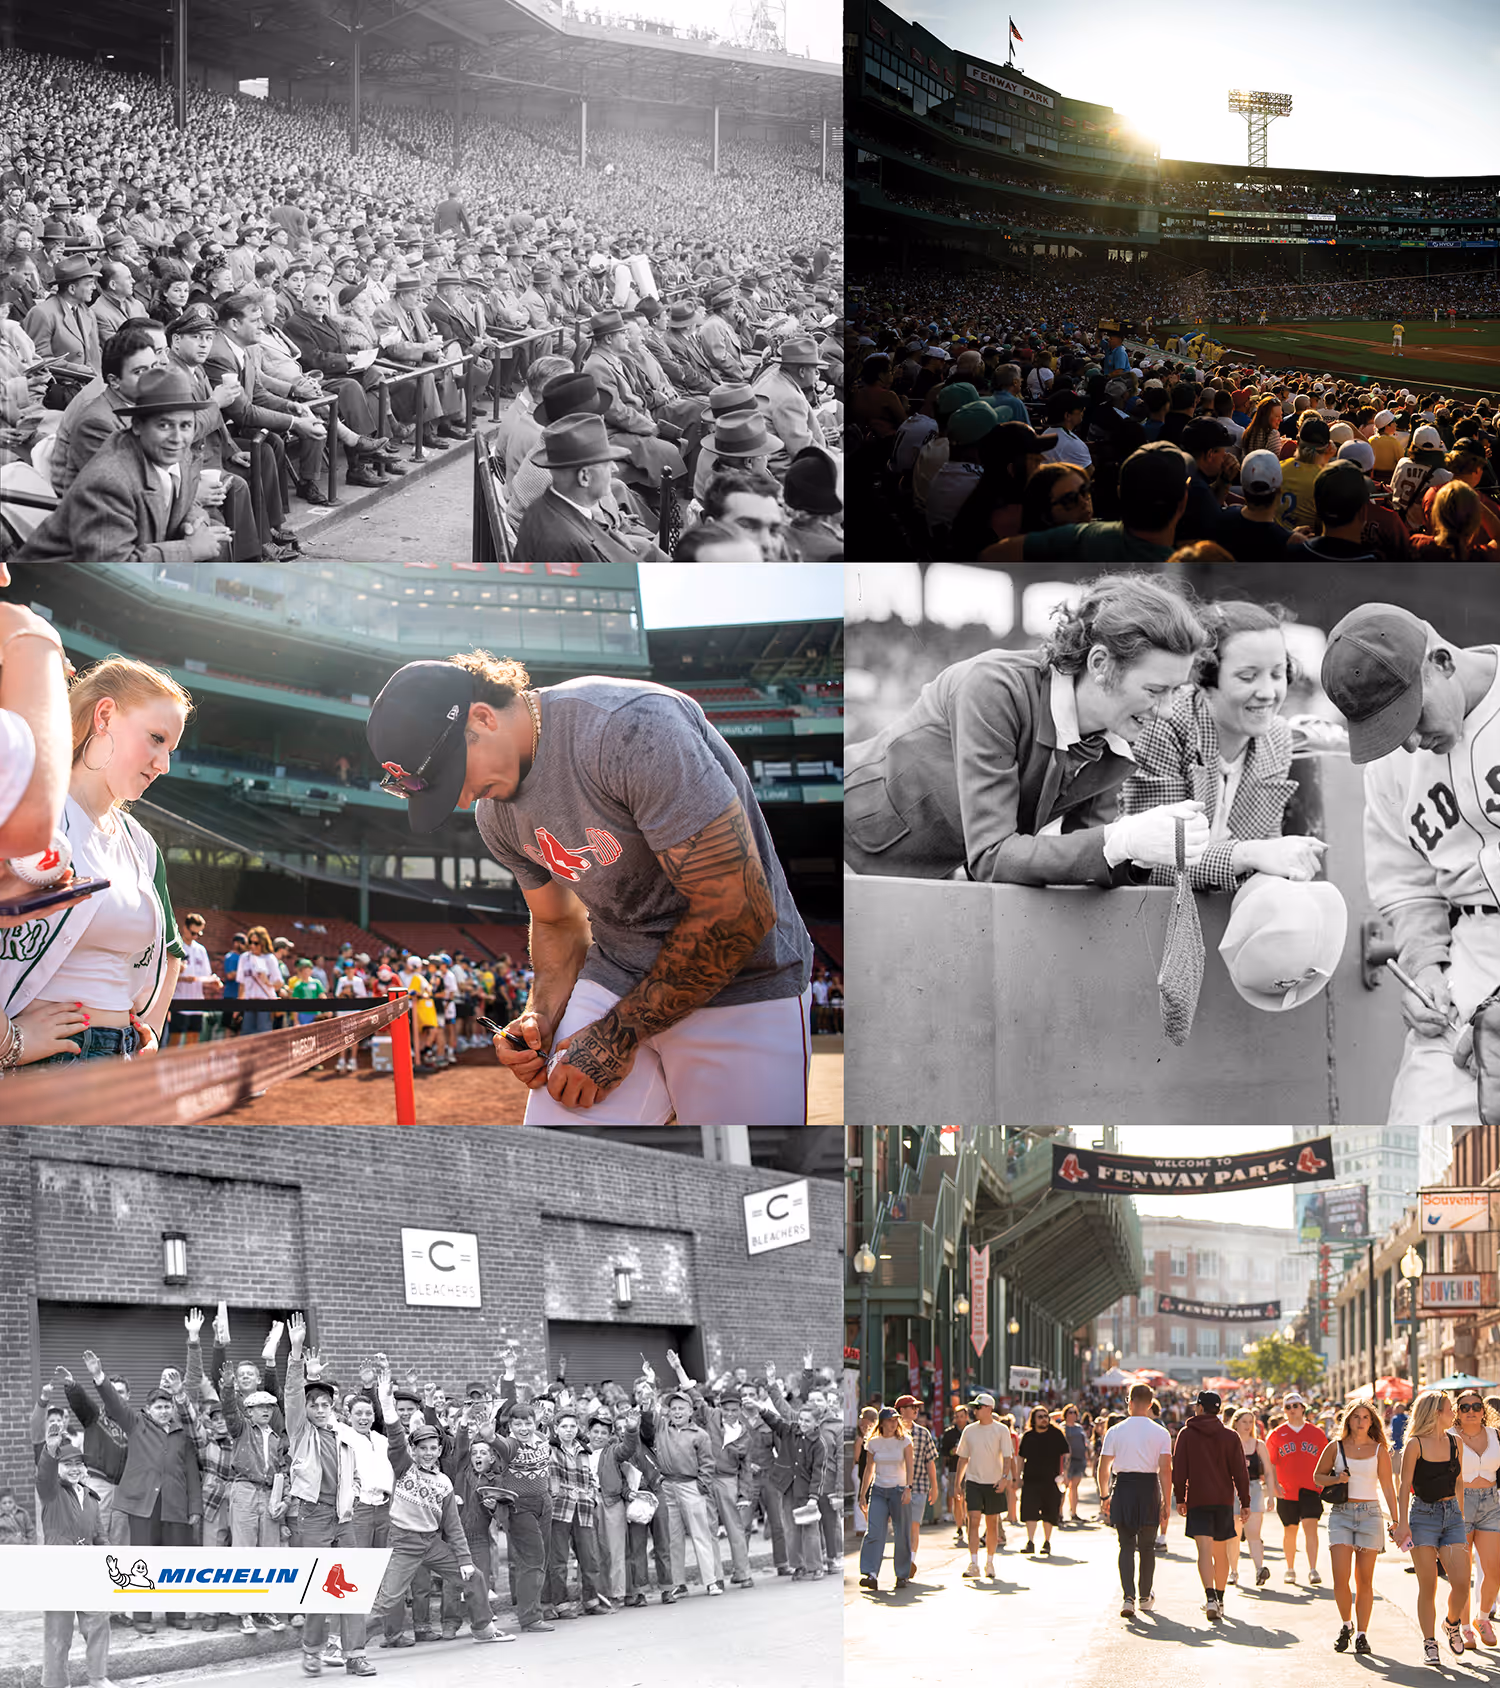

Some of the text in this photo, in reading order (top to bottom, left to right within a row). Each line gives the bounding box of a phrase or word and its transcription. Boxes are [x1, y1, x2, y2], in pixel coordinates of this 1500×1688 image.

[972, 69, 1049, 105] FENWAY PARK
[1097, 1158, 1288, 1188] FENWAY PARK
[1154, 1157, 1232, 1168] WELCOME TO
[766, 1193, 789, 1220] C
[1423, 1193, 1489, 1206] Souvenirs
[751, 1224, 806, 1247] BLEACHERS
[428, 1240, 456, 1272] C
[410, 1282, 475, 1298] BLEACHERS
[1423, 1280, 1480, 1302] SOUVENIRS
[1177, 1303, 1226, 1317] FENWAY
[1227, 1307, 1262, 1318] PARK
[1278, 1441, 1319, 1457] RED SOX
